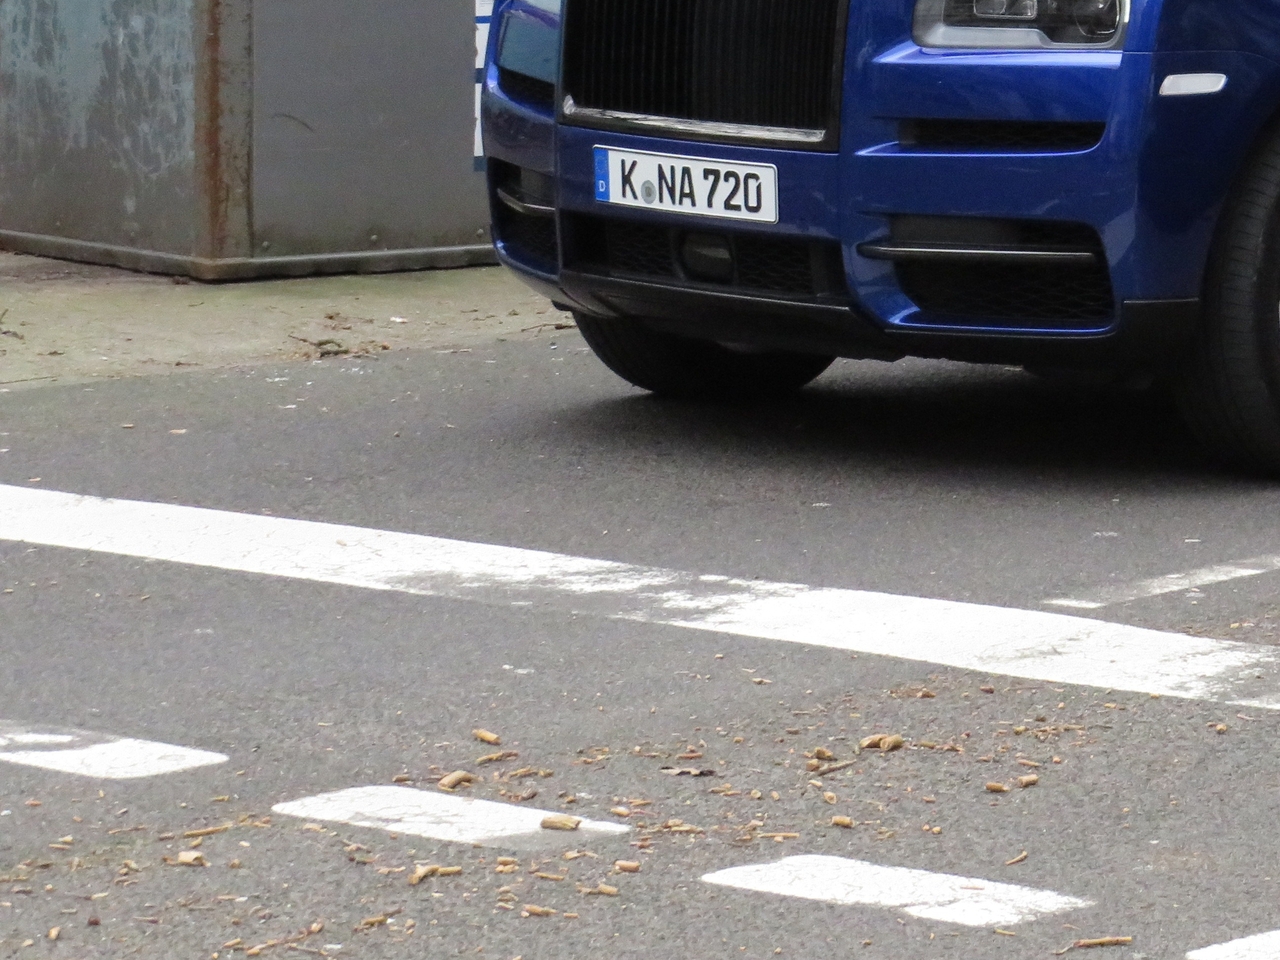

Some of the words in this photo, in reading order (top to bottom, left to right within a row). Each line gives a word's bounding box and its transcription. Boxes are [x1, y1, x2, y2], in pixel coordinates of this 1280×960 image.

[598, 180, 606, 192] D
[620, 158, 638, 200] K
[657, 163, 697, 207] NA
[703, 167, 762, 213] 720
